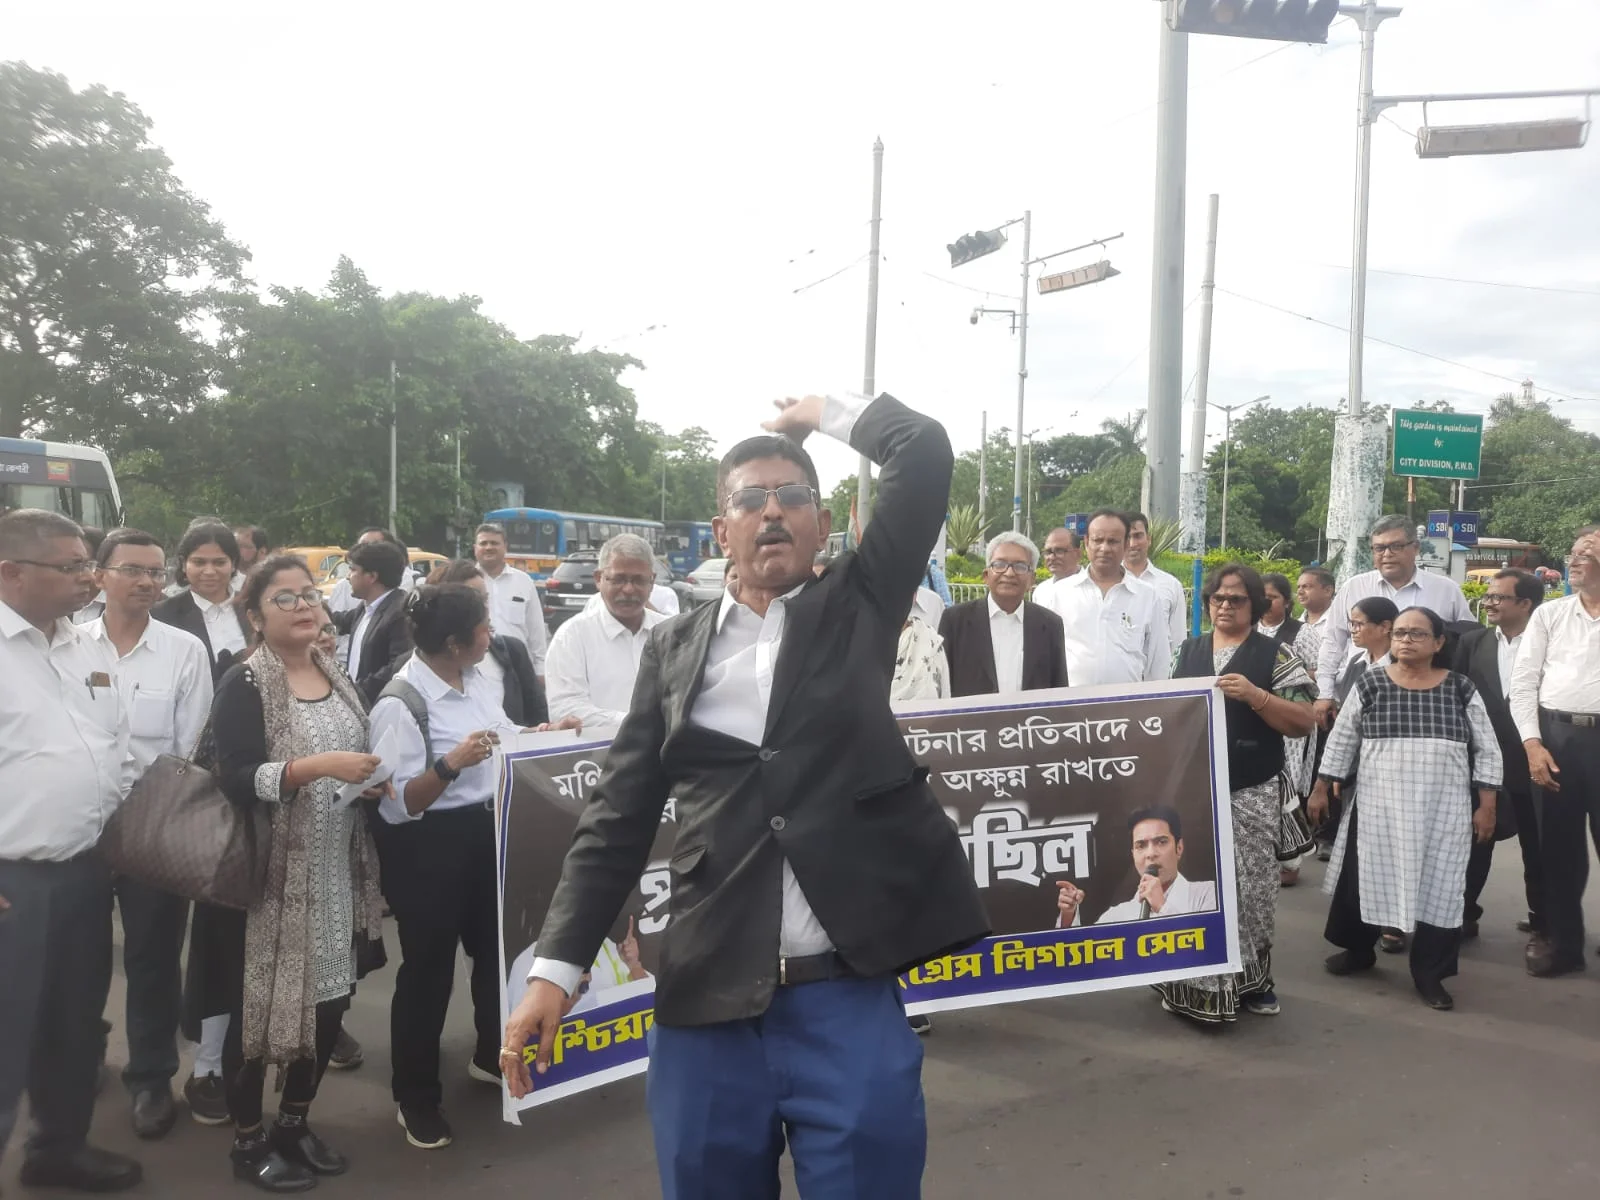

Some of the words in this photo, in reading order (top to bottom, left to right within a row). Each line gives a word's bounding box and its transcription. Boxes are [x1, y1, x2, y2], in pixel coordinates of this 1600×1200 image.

[1400, 418, 1413, 431] This
[1413, 421, 1436, 431] garden
[1436, 422, 1443, 432] is
[1443, 423, 1478, 433] maintained
[1400, 457, 1417, 467] CITY
[1418, 459, 1453, 470] DIVISION,
[1435, 522, 1447, 532] SBI
[1460, 523, 1476, 533] SBI
[903, 726, 988, 756] টনার
[998, 715, 1131, 751] প্রতিবাদে
[1138, 716, 1164, 736] ও
[1036, 755, 1139, 785] রাখতে
[991, 936, 1126, 975] লিগ্যাল
[1136, 927, 1206, 957] সেল
